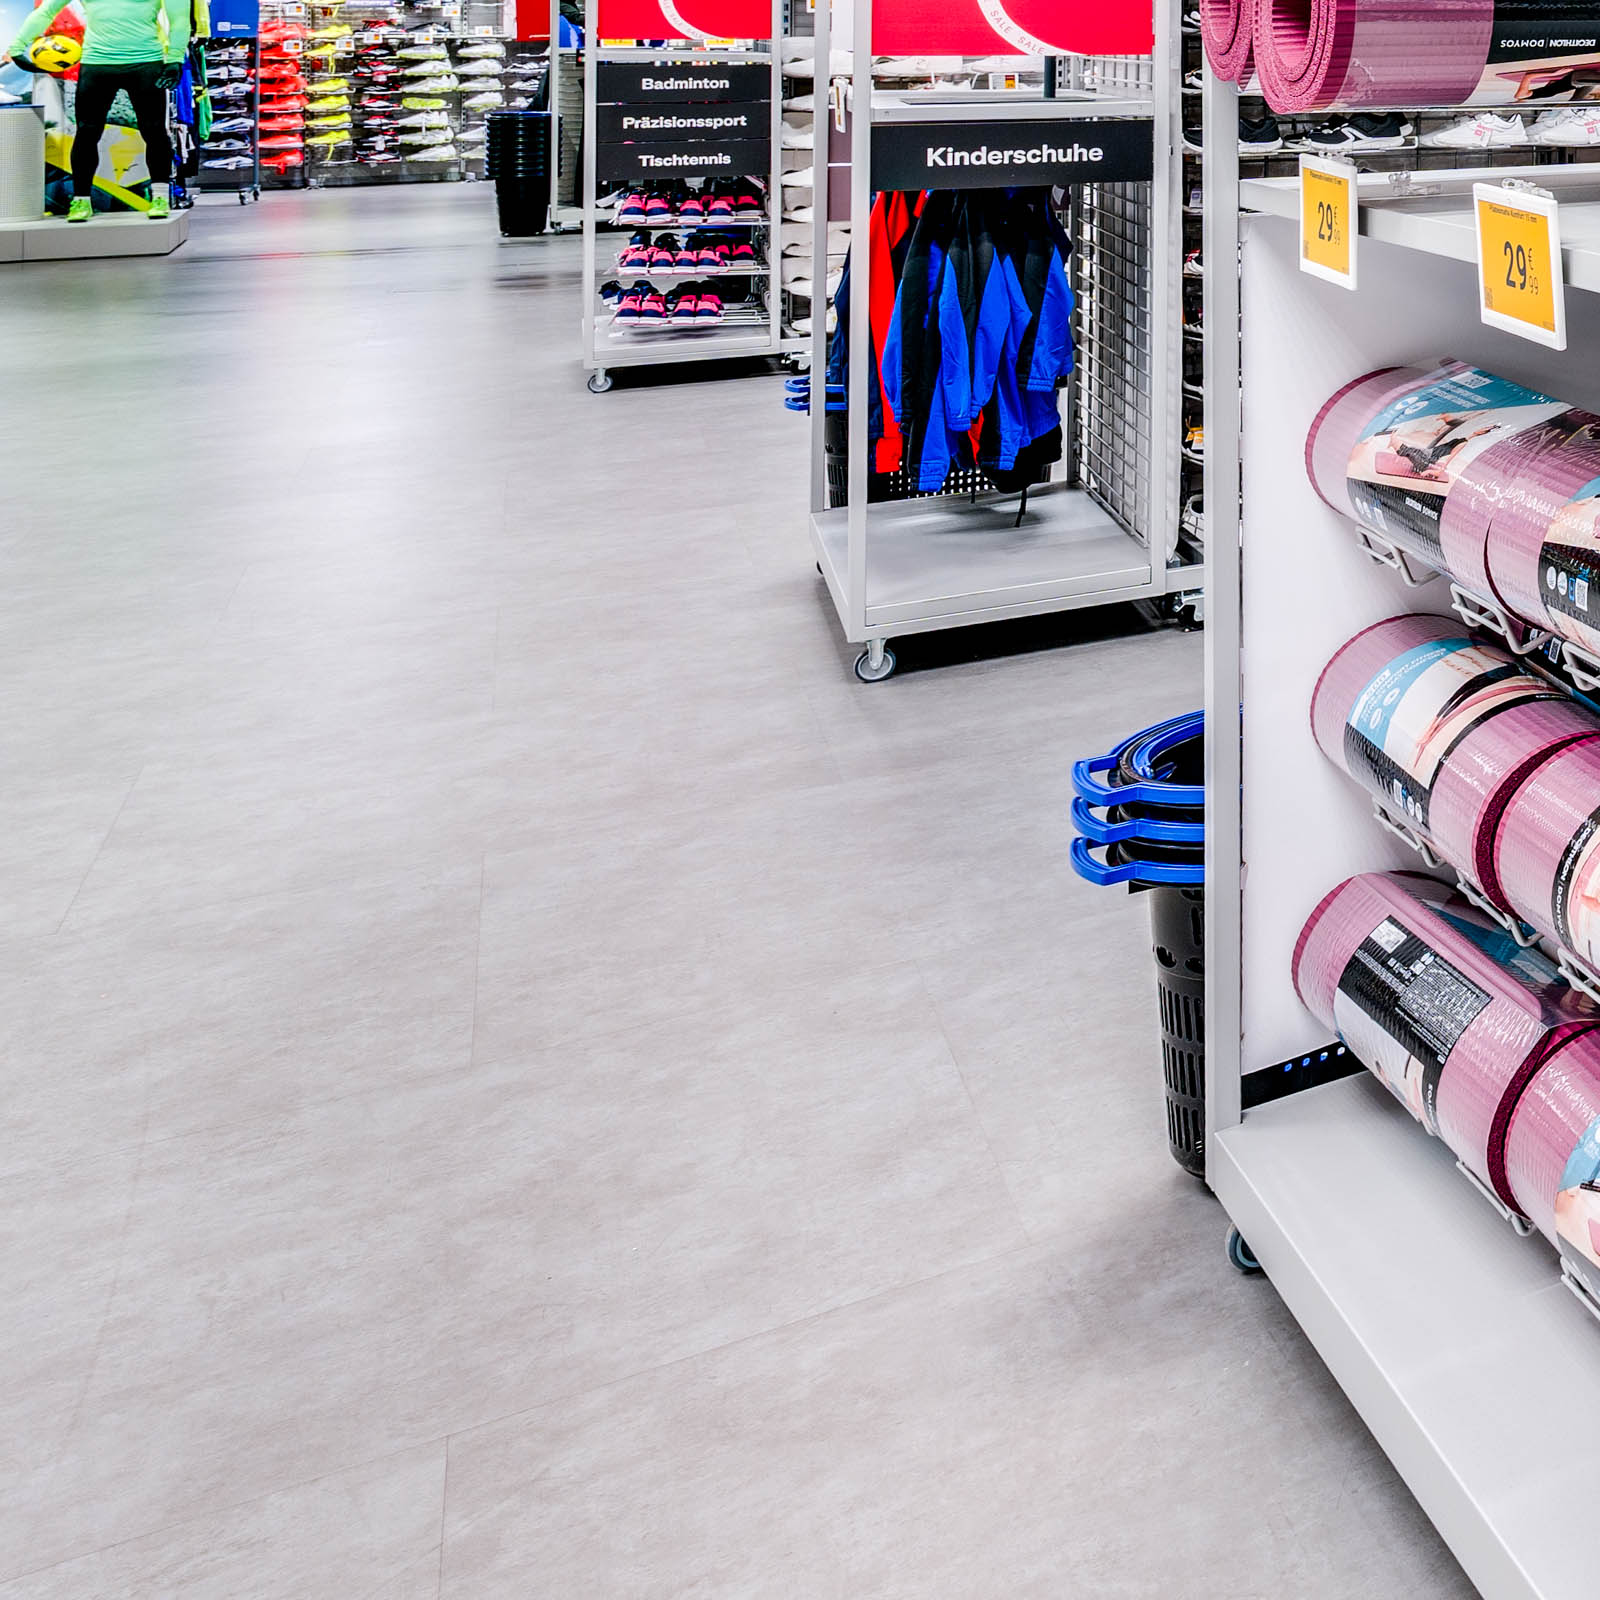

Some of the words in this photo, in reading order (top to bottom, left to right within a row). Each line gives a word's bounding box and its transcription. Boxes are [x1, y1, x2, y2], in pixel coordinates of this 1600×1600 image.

[990, 10, 1013, 34] SALE
[1500, 39, 1545, 49] DOMYOS
[1549, 39, 1597, 48] DECATHLON
[641, 77, 730, 91] Badminton
[622, 114, 748, 130] Präzisionssport
[637, 153, 731, 167] Tischtennis
[925, 143, 1104, 168] Kinderschuhe
[1318, 201, 1333, 242] 29
[1504, 240, 1527, 290] 29
